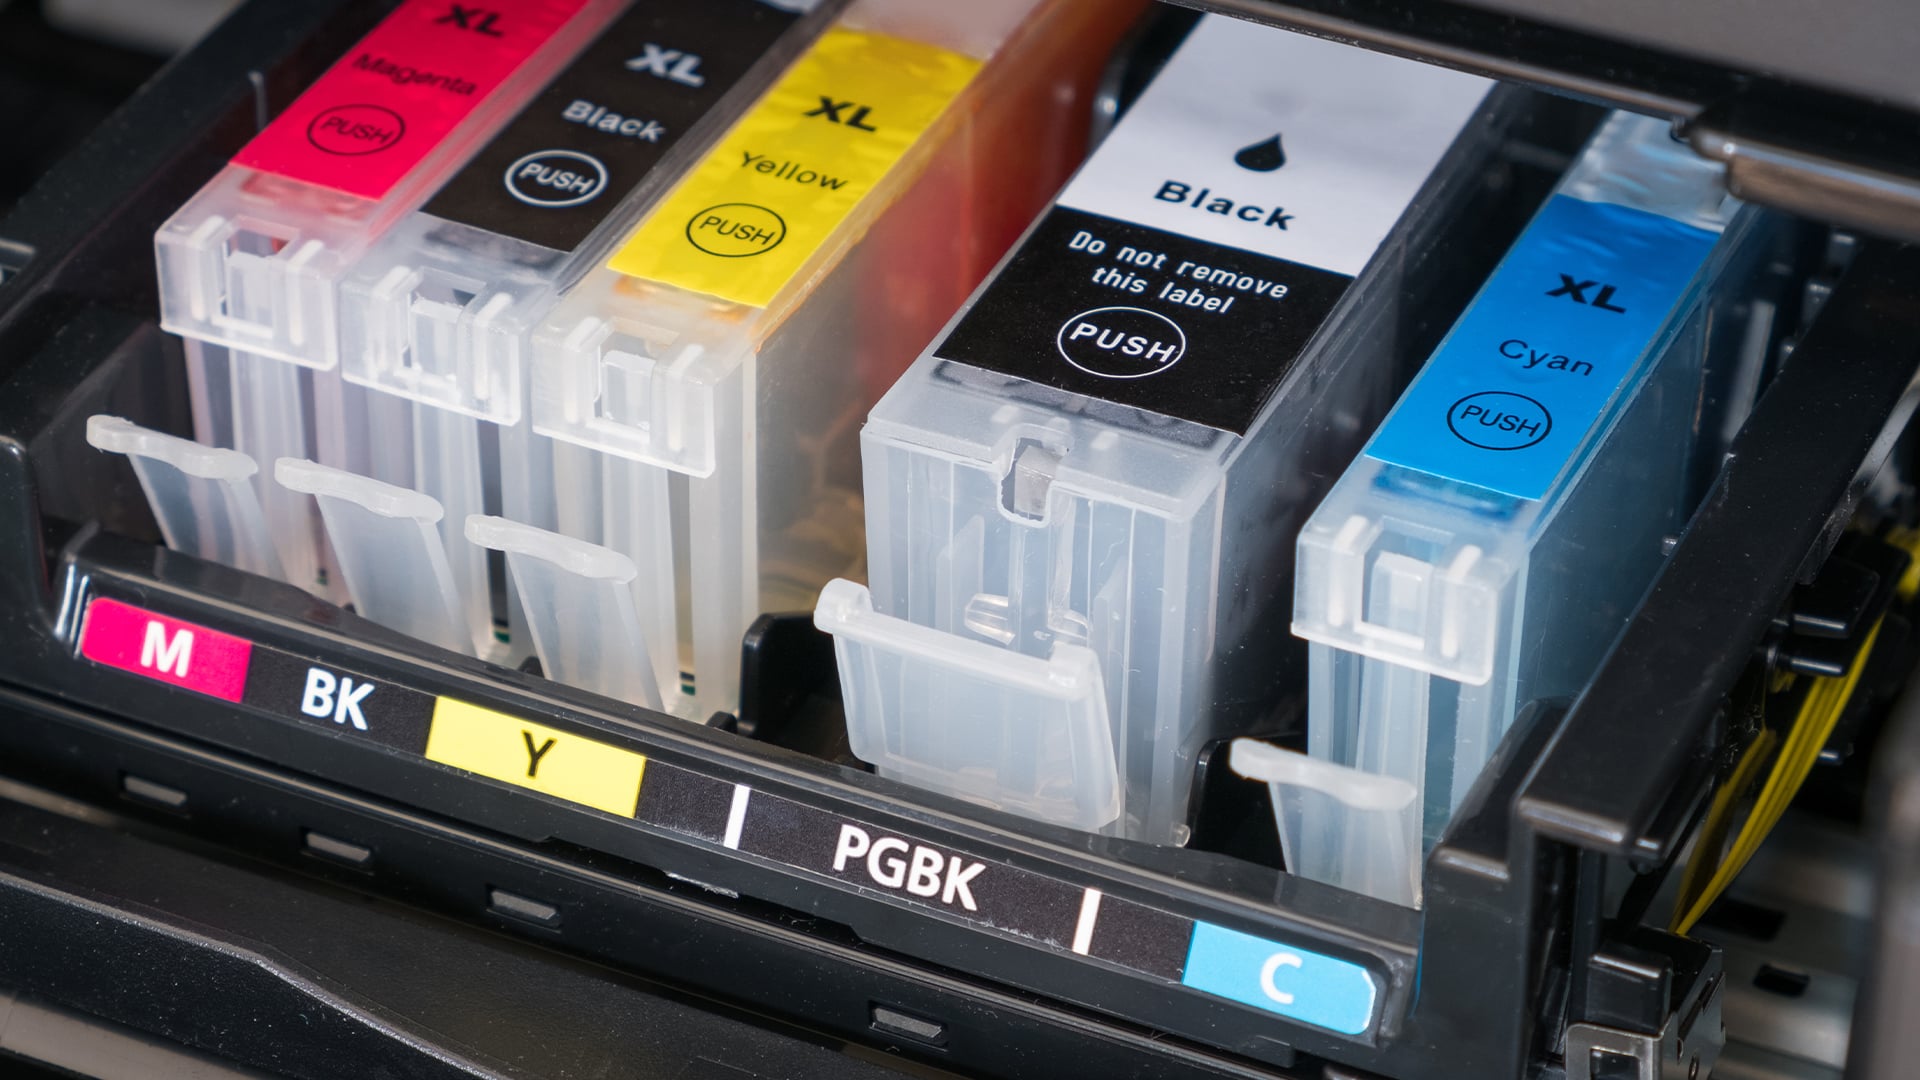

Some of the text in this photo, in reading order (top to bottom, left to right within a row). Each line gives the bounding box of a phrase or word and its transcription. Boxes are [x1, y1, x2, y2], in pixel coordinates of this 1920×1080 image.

[434, 3, 504, 38] XL
[352, 53, 476, 97] Magenta
[626, 42, 704, 87] XL
[320, 116, 393, 146] PUSH
[562, 100, 666, 144] Black
[804, 95, 877, 132] XL
[519, 161, 595, 195] PUSH
[741, 150, 848, 192] Yellow
[1154, 180, 1297, 232] Black
[699, 215, 775, 248] PUSH
[1069, 230, 1289, 299] Do not remove
[1092, 266, 1234, 314] this label
[1545, 273, 1627, 315] XL
[1069, 322, 1176, 365] PUSH
[1498, 339, 1595, 377] Cyan
[1460, 405, 1542, 438] PUSH
[140, 620, 193, 678] M
[300, 667, 376, 731] BK
[521, 730, 557, 778] Y
[832, 824, 986, 912] PGBK
[1258, 952, 1303, 1005] C
